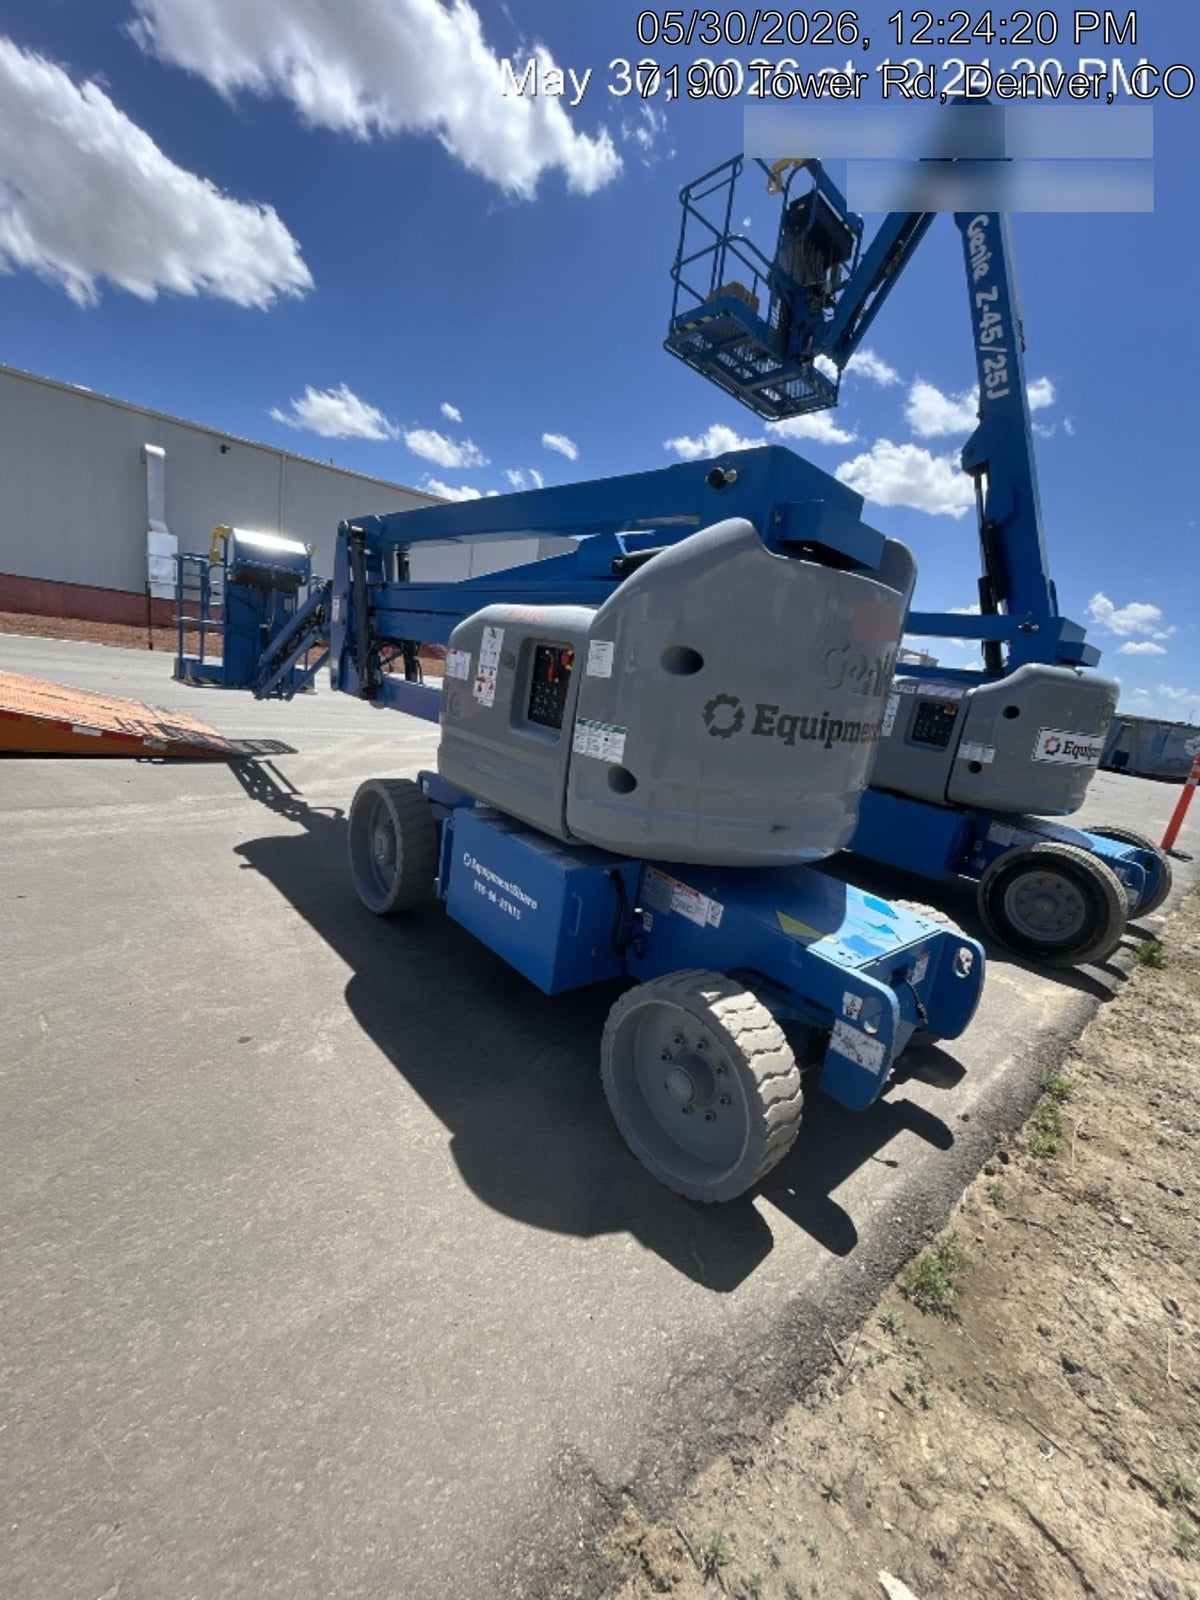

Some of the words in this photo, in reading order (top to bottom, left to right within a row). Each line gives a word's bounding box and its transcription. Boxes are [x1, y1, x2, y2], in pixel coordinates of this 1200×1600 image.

[966, 213, 991, 285] Genie
[975, 285, 1010, 399] Z-45/25J
[751, 703, 881, 749] Equipmen
